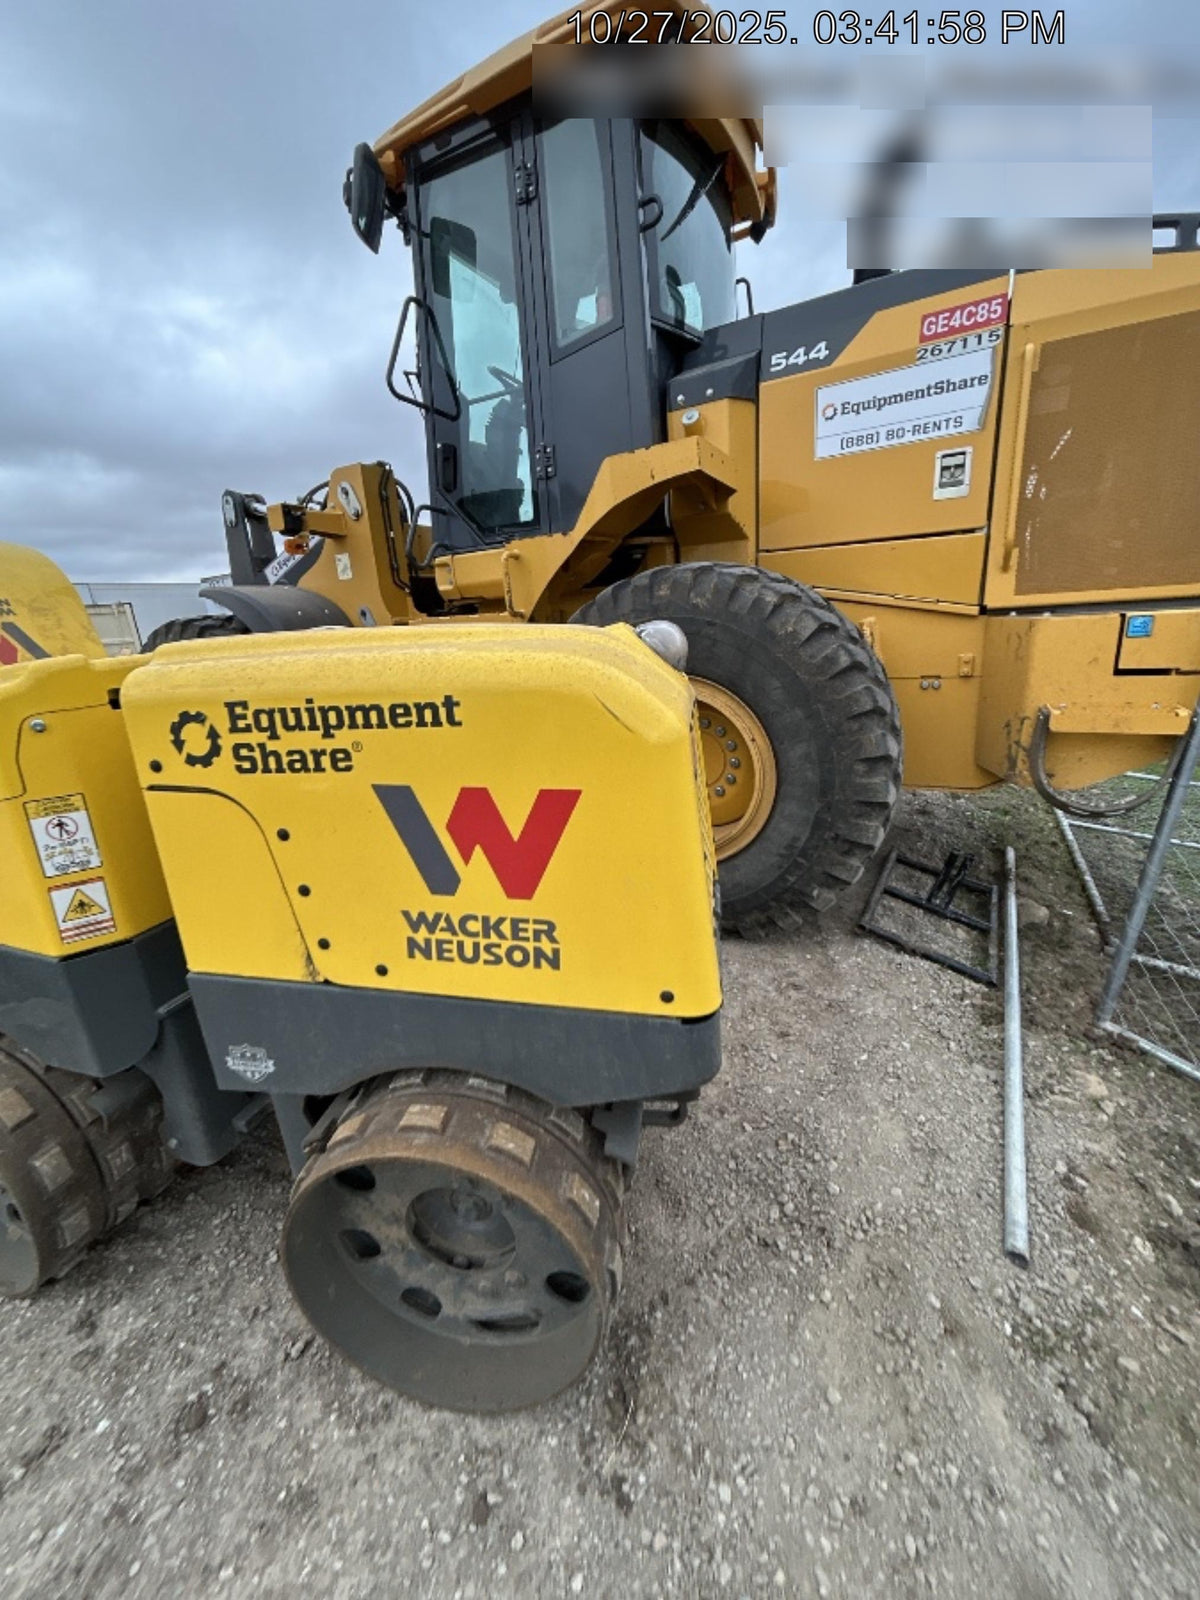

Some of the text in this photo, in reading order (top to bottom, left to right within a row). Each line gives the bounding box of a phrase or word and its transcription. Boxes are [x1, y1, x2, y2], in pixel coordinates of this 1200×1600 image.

[922, 299, 1003, 337] GE4C85
[769, 340, 830, 373] 544
[917, 328, 1001, 361] 267115
[840, 374, 990, 417] EquipmentShare
[885, 416, 964, 441] 80-RENTS
[224, 695, 463, 740] Equipment
[400, 909, 560, 944] WACKER
[406, 936, 560, 971] NEUSON
